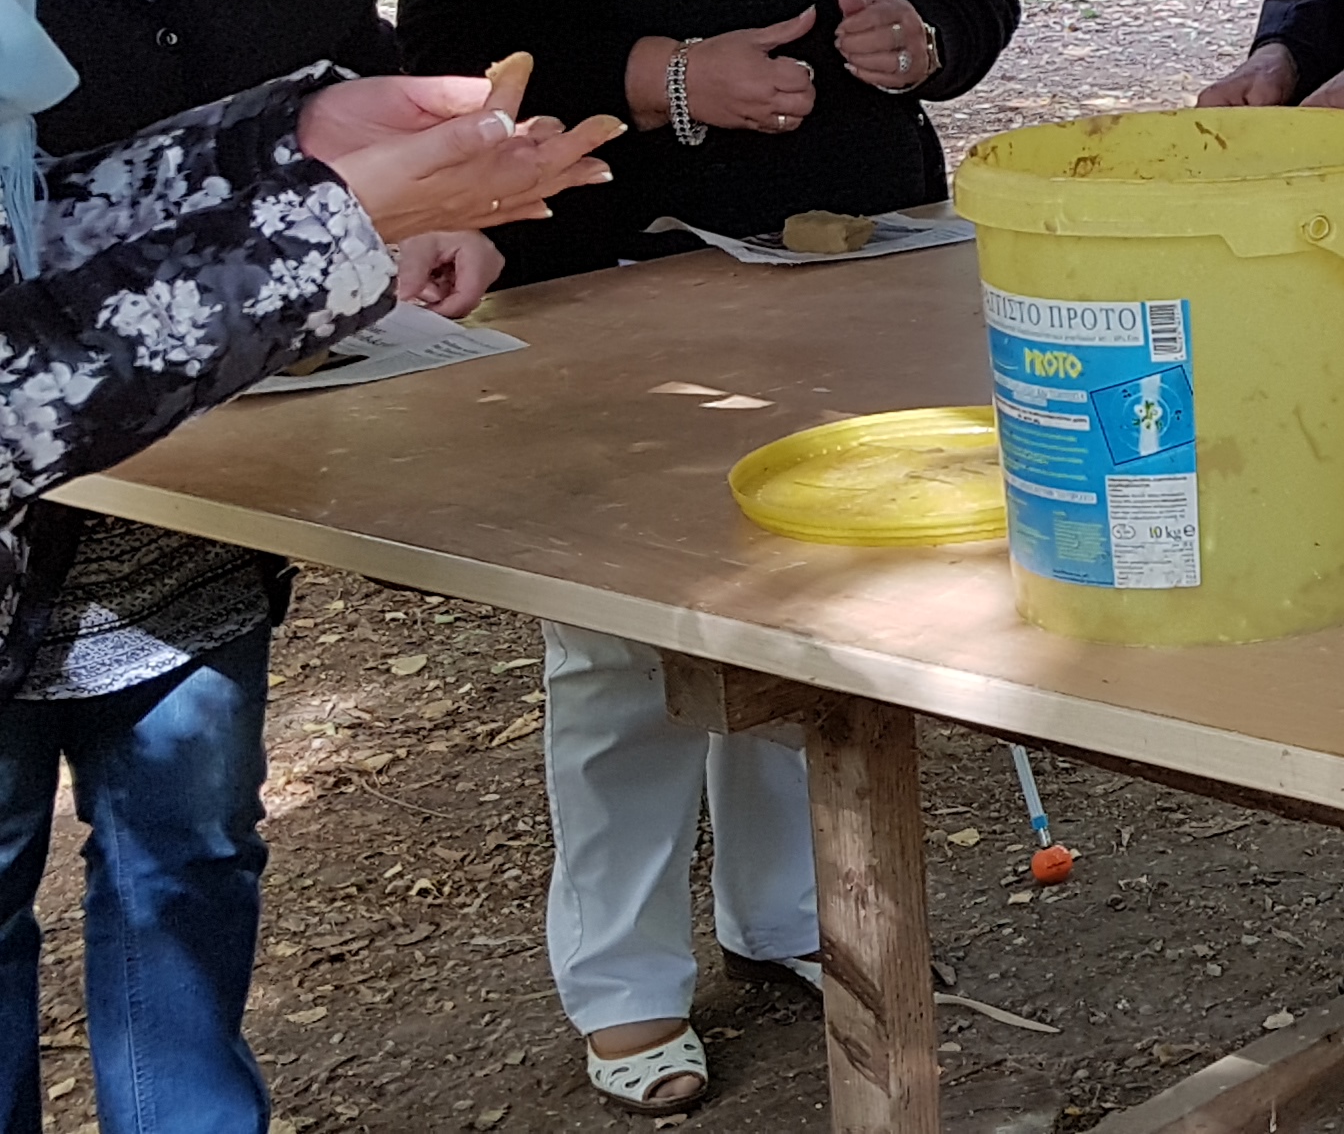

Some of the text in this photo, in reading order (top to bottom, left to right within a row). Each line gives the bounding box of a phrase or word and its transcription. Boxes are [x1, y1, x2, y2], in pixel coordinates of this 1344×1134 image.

[1048, 304, 1137, 331] ΠΡΟΤΟ
[1023, 347, 1083, 379] PROTO
[1149, 526, 1163, 538] 10
